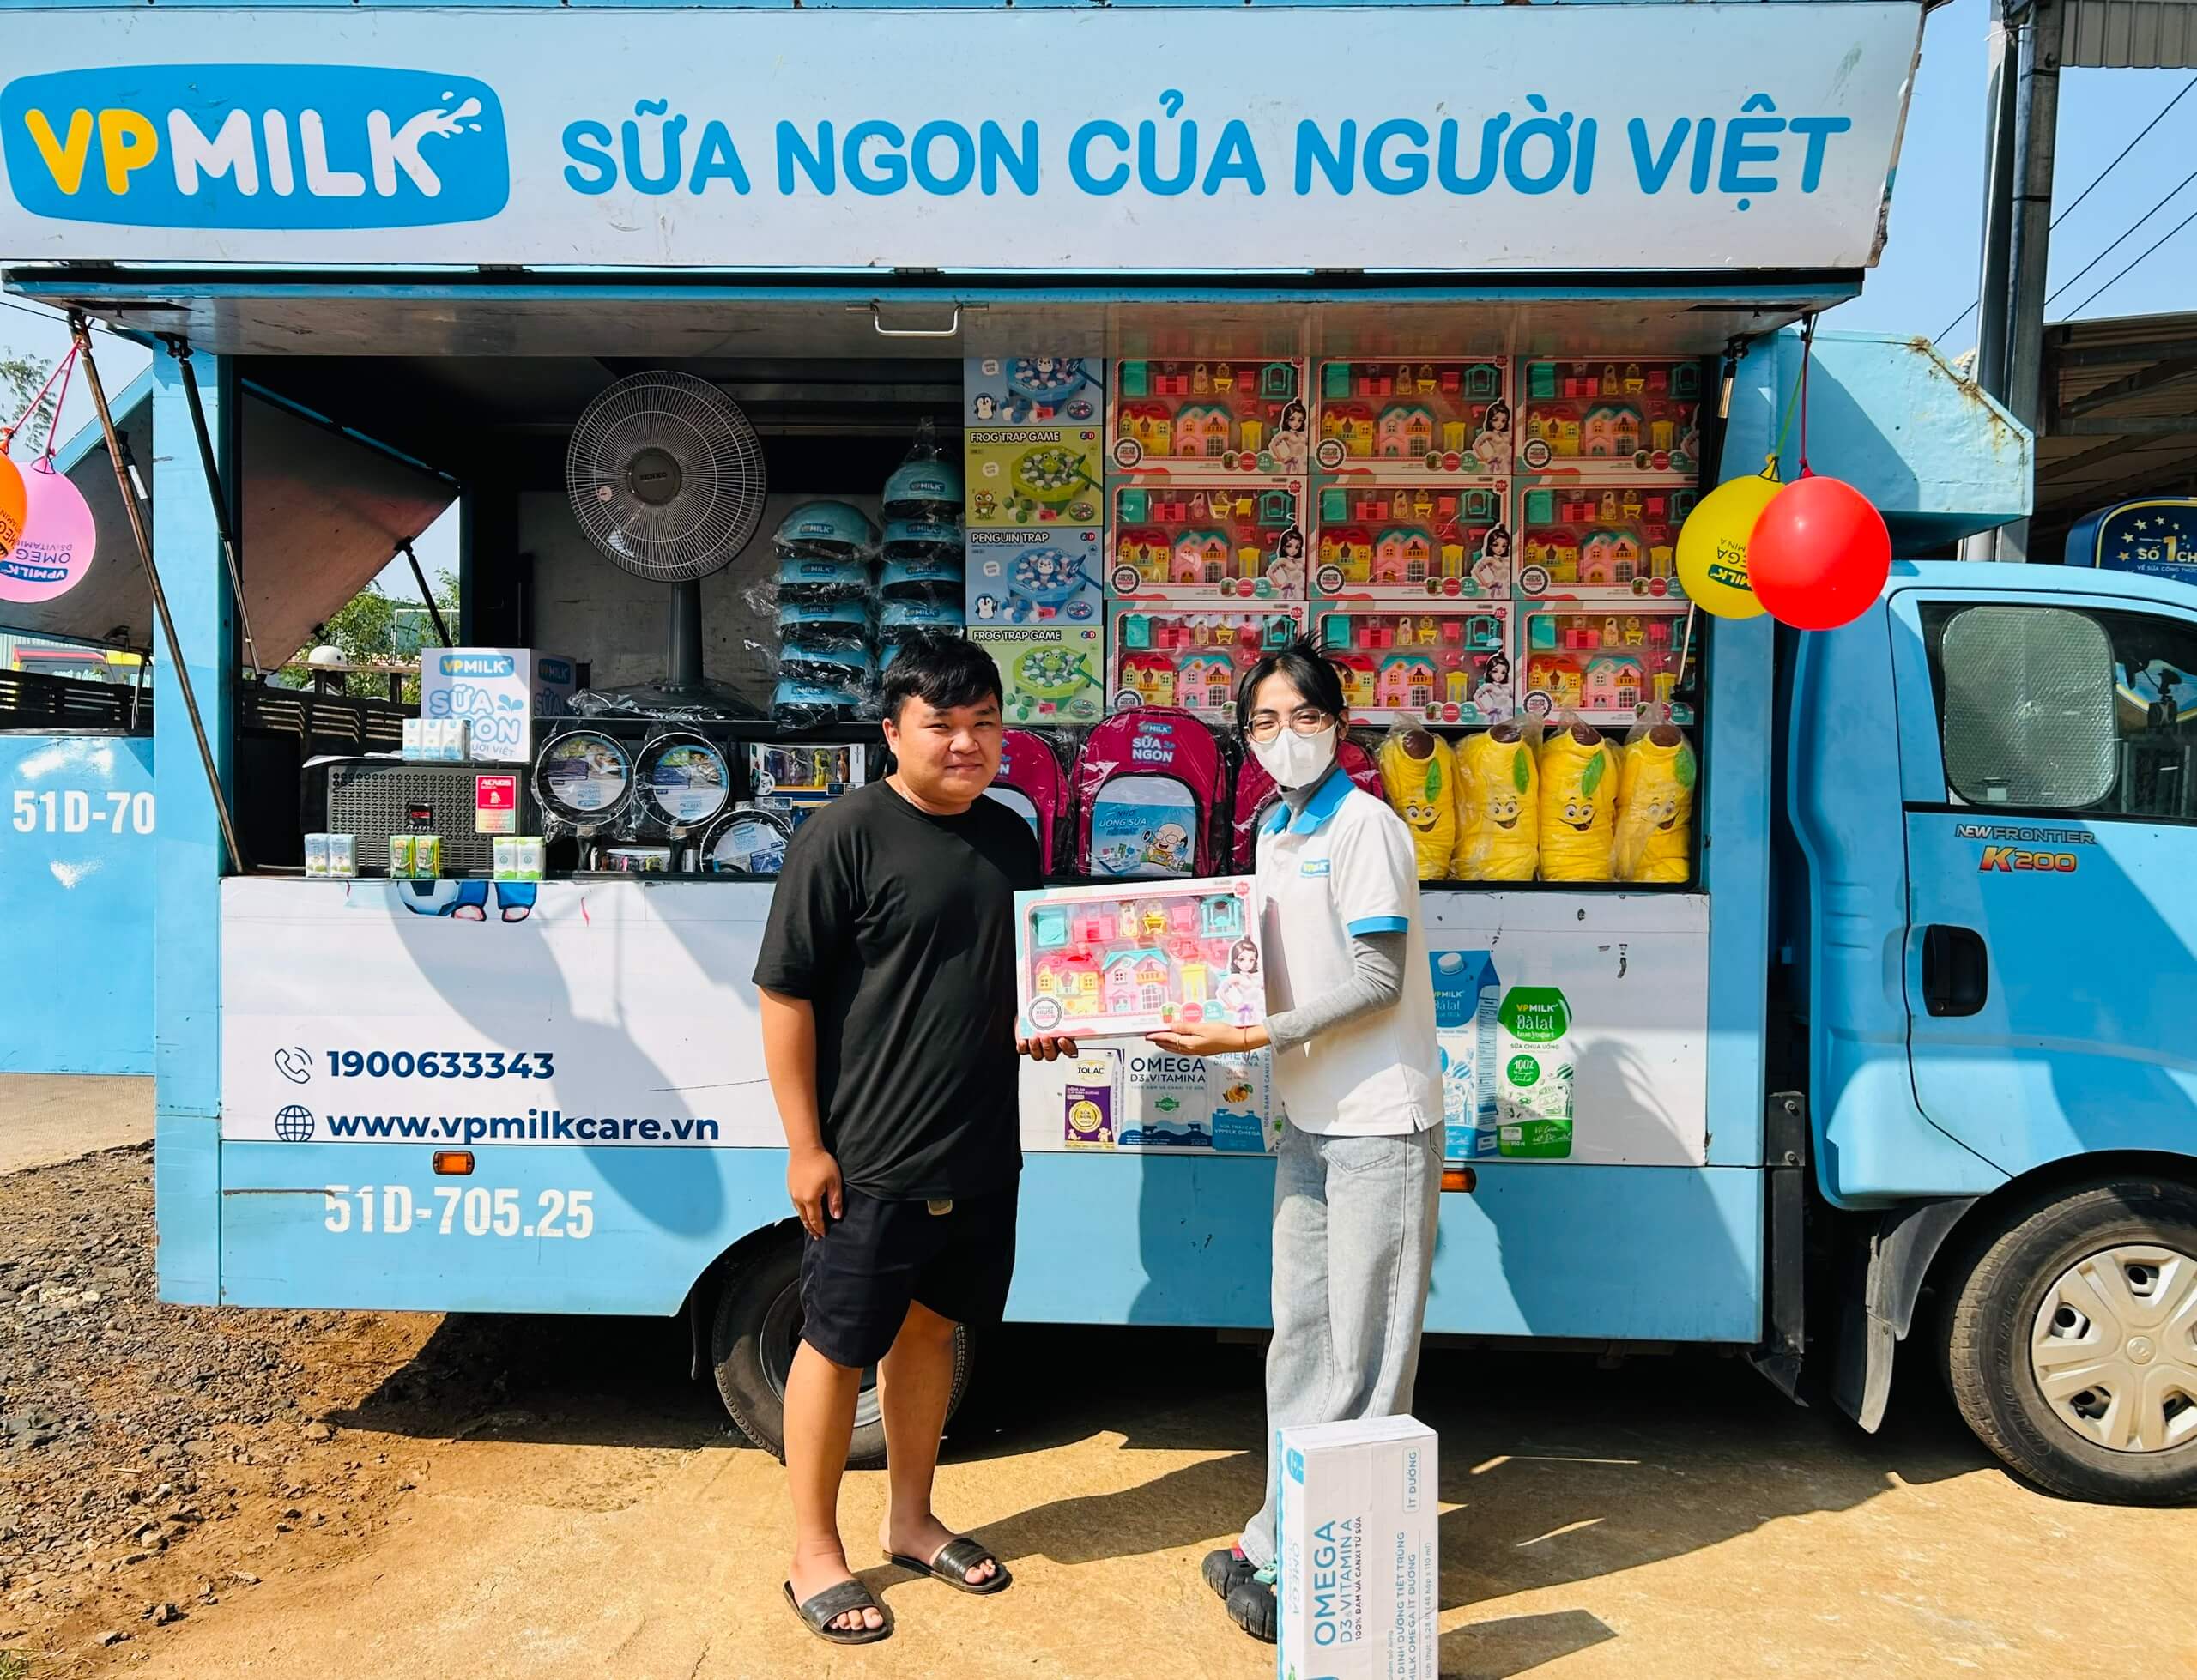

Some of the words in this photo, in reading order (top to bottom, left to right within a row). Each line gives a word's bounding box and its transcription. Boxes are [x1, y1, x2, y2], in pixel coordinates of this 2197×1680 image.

[24, 91, 481, 197] VPMILK
[561, 98, 751, 196] SỮA
[776, 119, 1038, 196] NGON
[1069, 89, 1266, 196] CỦA
[1293, 94, 1598, 196] NGƯỜI
[1627, 93, 1852, 212] VIỆT
[971, 432, 999, 444] FROG
[1001, 432, 1027, 443] TRAP
[1028, 432, 1061, 442] GAME
[971, 532, 1020, 543] PENGUIN
[1022, 532, 1050, 542] TRAP
[15, 548, 71, 564] OMEG
[2138, 545, 2160, 560] SỐ
[2163, 535, 2177, 562] 1
[2, 565, 65, 579] VPMILK
[973, 630, 1001, 641] FROG
[1002, 631, 1029, 641] TRAP
[1030, 630, 1062, 640] GAME
[443, 657, 511, 674] VPMILK
[429, 683, 494, 716] SỮA
[1132, 735, 1161, 749] SỮA
[1132, 749, 1173, 763] NGON
[13, 790, 155, 836] 51D-70
[1993, 826, 2097, 845] FRONTIER
[1979, 845, 2077, 873] K200
[1516, 1004, 1558, 1012] VPMILK
[326, 1050, 554, 1079] 1900633343
[1130, 1057, 1206, 1073] OMEGA
[327, 1109, 719, 1144] www.vpmilkcare.vn
[324, 1184, 593, 1239] 51D-705.25
[1340, 1518, 1353, 1531] A
[1314, 1520, 1336, 1646] OMEGA
